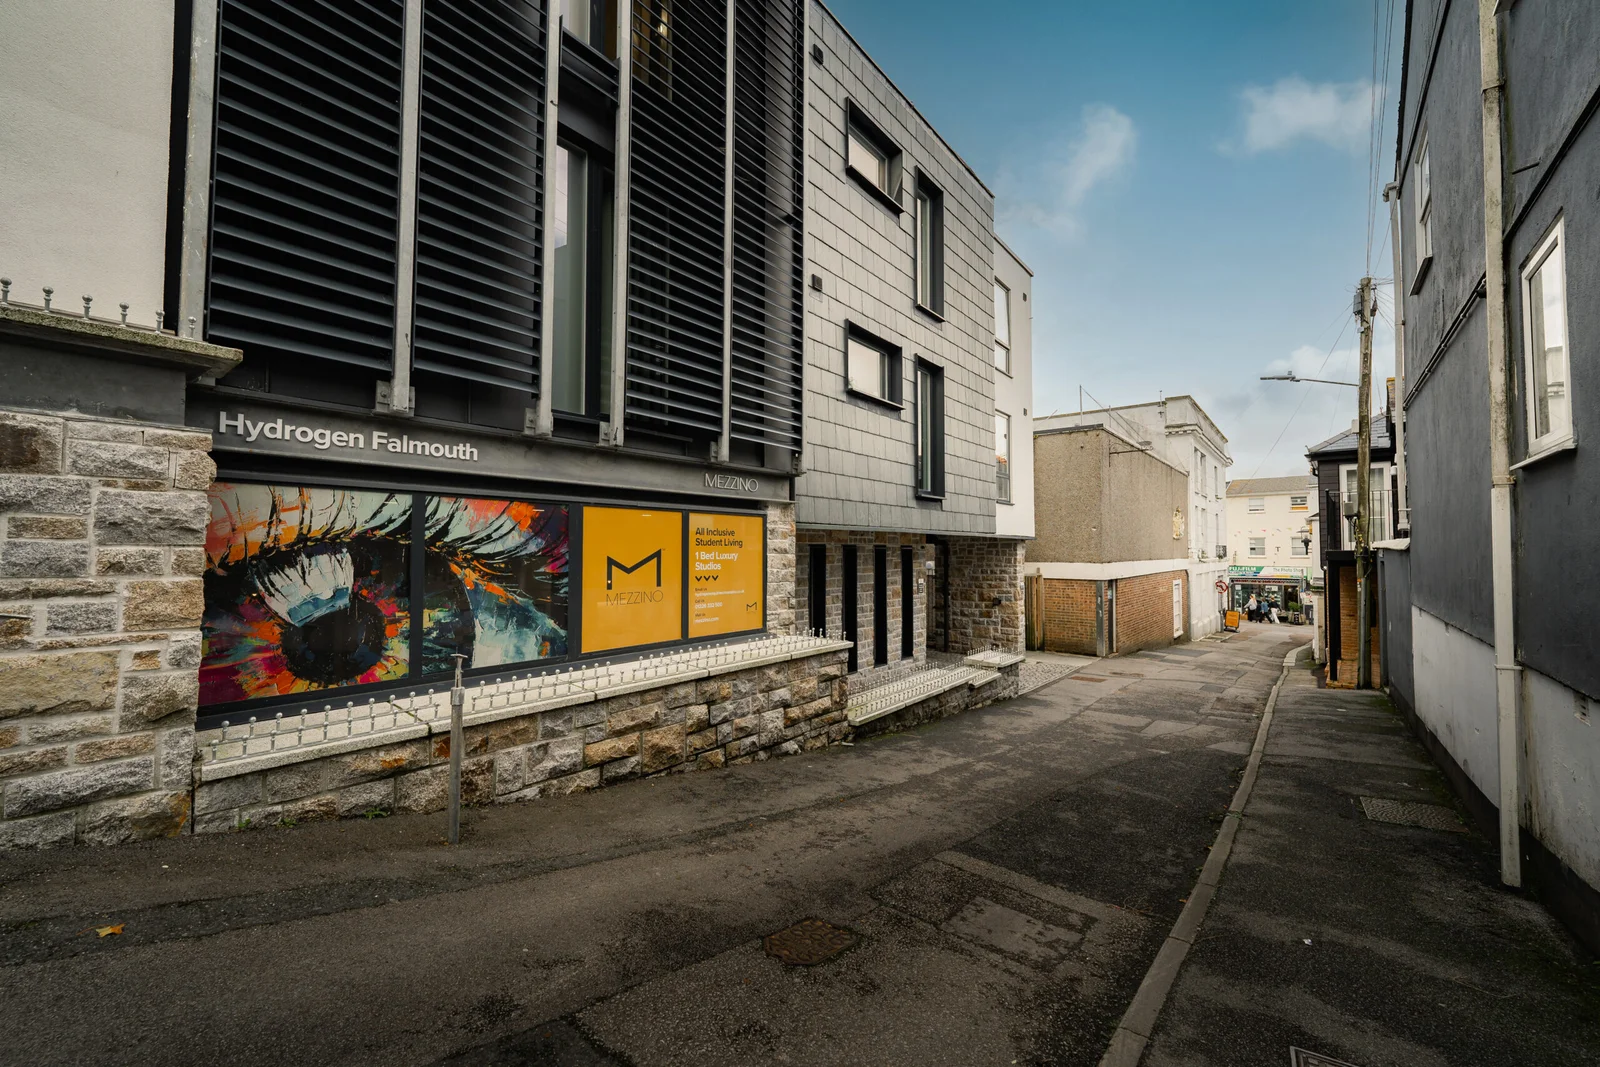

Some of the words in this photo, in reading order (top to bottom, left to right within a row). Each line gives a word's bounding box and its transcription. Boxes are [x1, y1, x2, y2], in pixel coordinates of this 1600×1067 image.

[218, 411, 364, 450] Hydrogen
[372, 430, 478, 461] Falmouth
[705, 473, 759, 492] MEZZINO
[695, 527, 705, 536] All
[706, 528, 735, 537] Inclusive
[695, 538, 723, 547] Student
[723, 539, 743, 548] Living
[695, 552, 699, 560] 1
[700, 552, 715, 560] Bed
[715, 552, 738, 562] Luxury
[695, 562, 722, 571] Studios
[605, 590, 664, 606] MEZZINO
